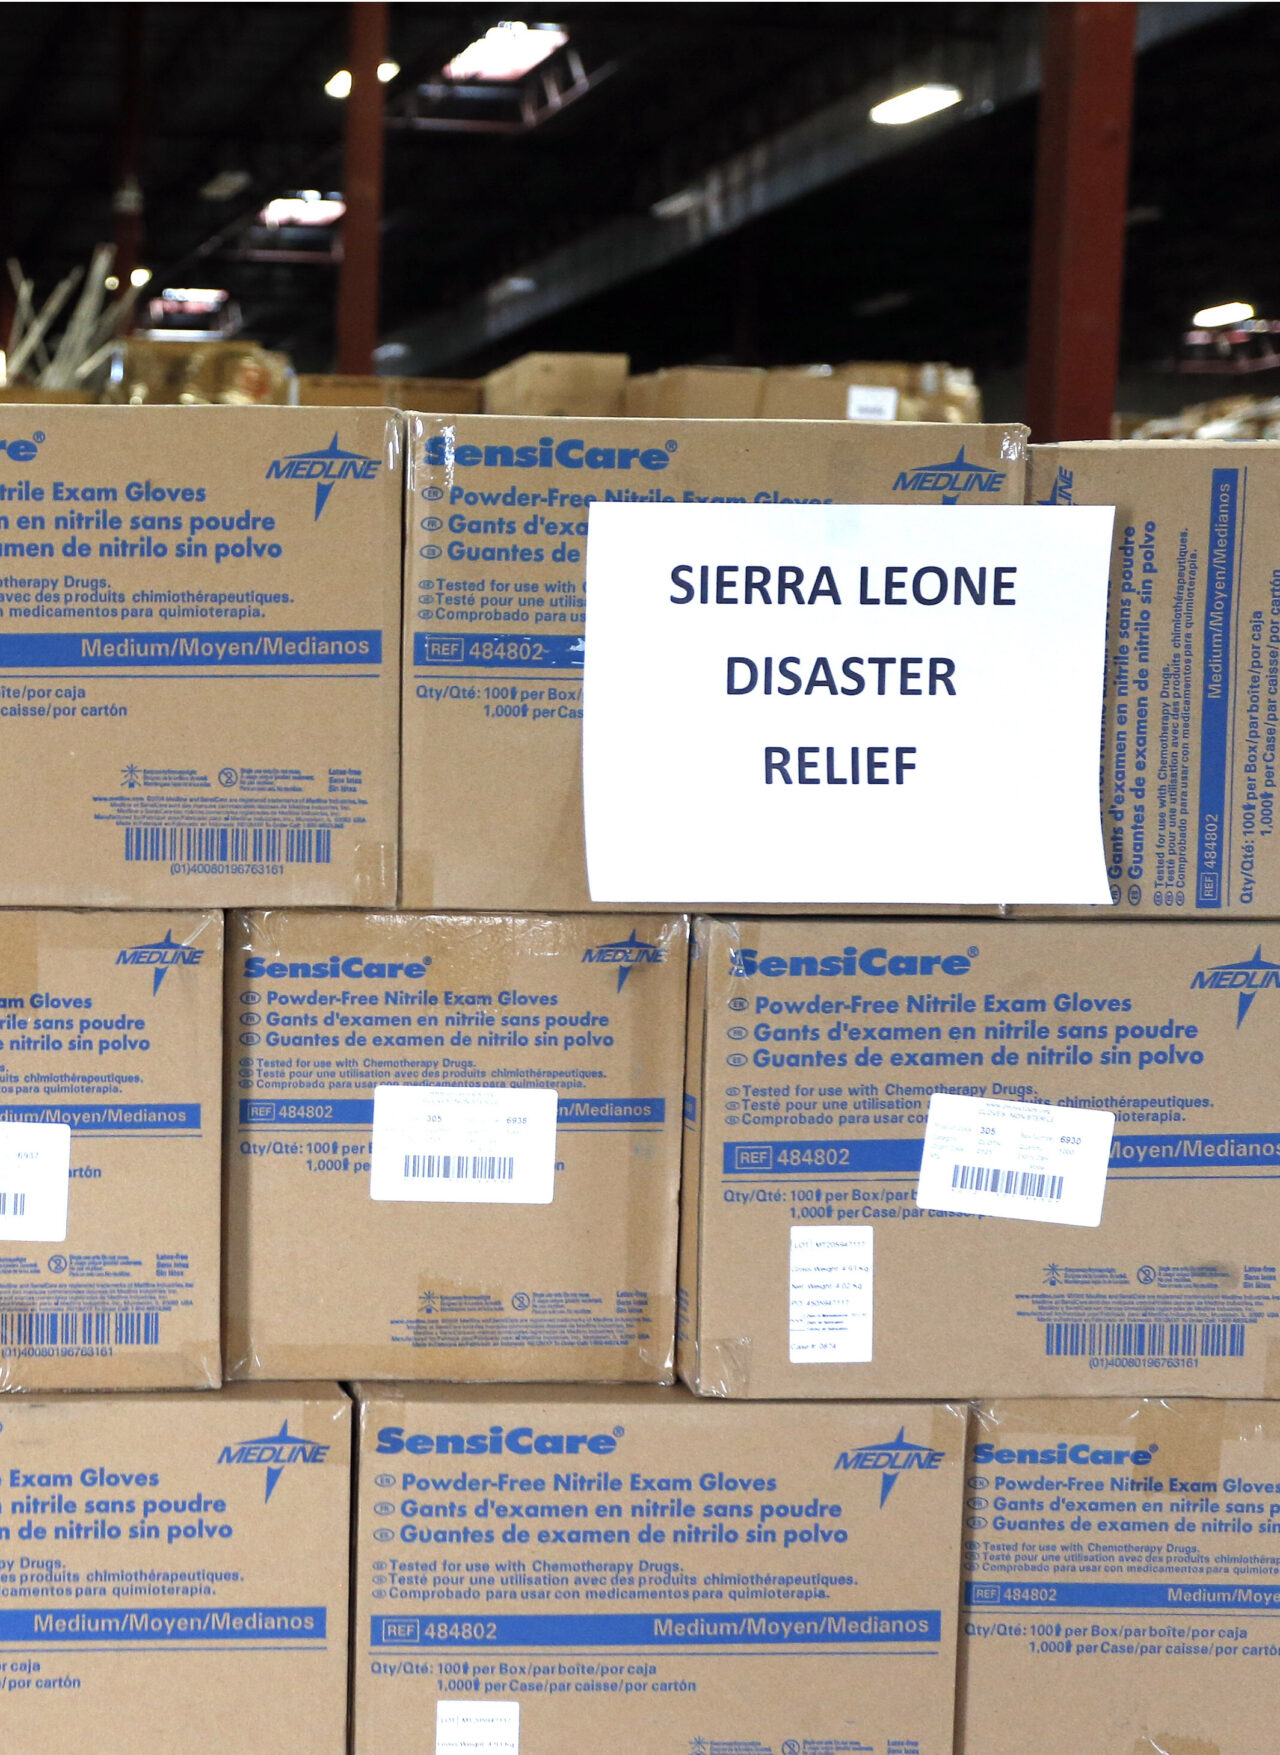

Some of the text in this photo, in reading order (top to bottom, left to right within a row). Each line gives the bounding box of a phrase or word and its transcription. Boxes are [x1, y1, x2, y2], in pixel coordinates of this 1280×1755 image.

[266, 460, 382, 480] MEDLINE
[892, 468, 1007, 492] MEDLINE
[53, 482, 118, 501] Exam
[125, 480, 206, 502] Gloves
[450, 485, 592, 511] Powder-Free
[16, 516, 45, 530] en
[54, 509, 122, 530] nitrile
[130, 516, 183, 530] sans
[190, 509, 276, 534] poudre
[448, 514, 517, 535] Gants
[62, 536, 92, 557] de
[99, 536, 168, 557] nitrilo
[176, 534, 208, 558] sin
[215, 536, 283, 563] polvo
[448, 541, 581, 563] Guantes de
[64, 576, 110, 590] Drugs.
[671, 565, 1016, 605] SIERRA LEONE
[34, 590, 60, 603] des
[64, 591, 125, 605] produits
[132, 591, 293, 605] chimiothérapeutiques.
[9, 606, 118, 618] medicamentos
[120, 608, 153, 619] para
[159, 606, 264, 619] quimioterapia.
[430, 642, 543, 660] REF 484802
[727, 657, 956, 695] DISASTER
[55, 687, 86, 700] caja
[1127, 521, 1157, 880] Guantes de examen de nitrilo sin polvo
[765, 747, 916, 784] RELIEF
[1204, 815, 1218, 898] REF 484802
[115, 949, 205, 965] MEDLINE
[582, 948, 667, 962] MEDLINE
[1190, 970, 1280, 989] MEDLIN
[30, 993, 93, 1009] Gloves
[267, 990, 559, 1006] Powder-Free Nitrile Exam Gloves
[755, 992, 1132, 1015] Powder-Free Nitrile Exam Gloves
[249, 1106, 332, 1118] REF 484802
[740, 1149, 849, 1165] REF 484802
[217, 1444, 330, 1464] MEDLINE
[834, 1452, 945, 1470] MEDLINE
[9, 1469, 73, 1488] Exam
[80, 1467, 160, 1487] Gloves
[402, 1472, 777, 1492] Powder-Free Nitrile Exam Gloves
[995, 1476, 1280, 1494] Powder-Free Nitrile Exam Gloves
[974, 1587, 1057, 1601] REF 484802
[387, 1623, 496, 1639] REF 484802
